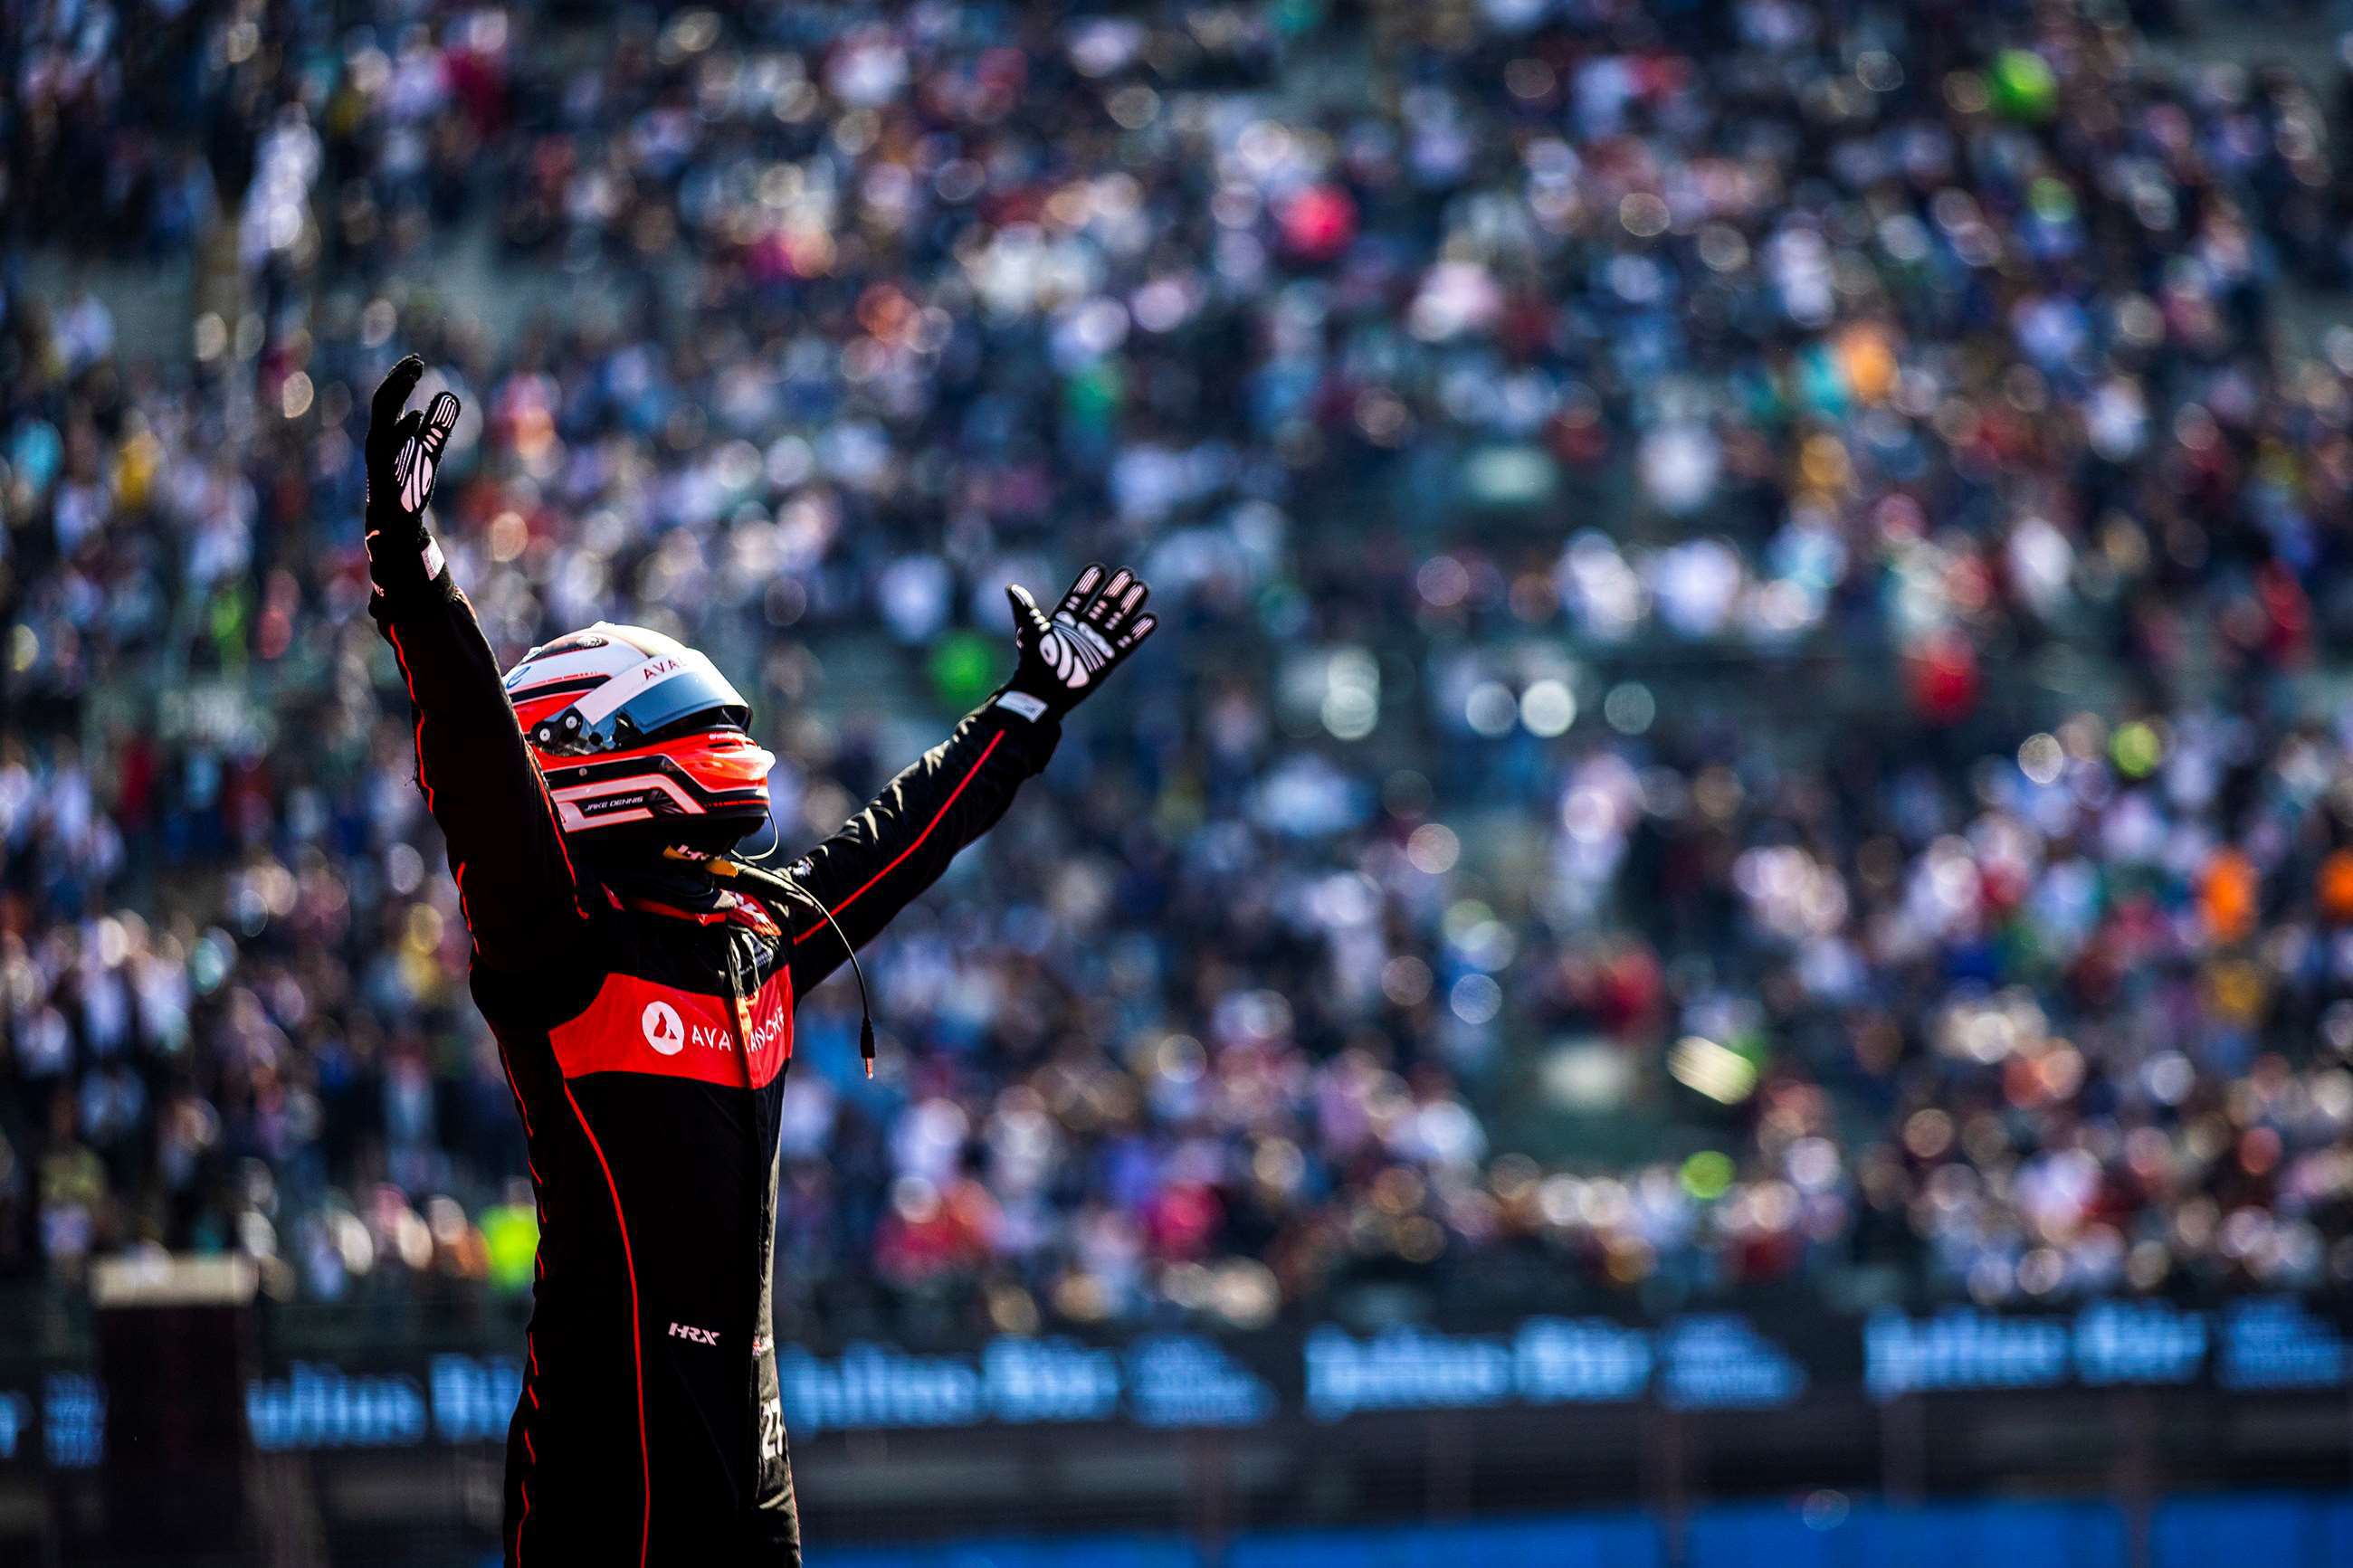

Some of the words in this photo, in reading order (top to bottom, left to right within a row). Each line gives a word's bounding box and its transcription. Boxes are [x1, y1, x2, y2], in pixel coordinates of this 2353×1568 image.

[585, 802, 607, 813] JAKE
[610, 795, 643, 807] DENNIS
[668, 1322, 721, 1346] HRX
